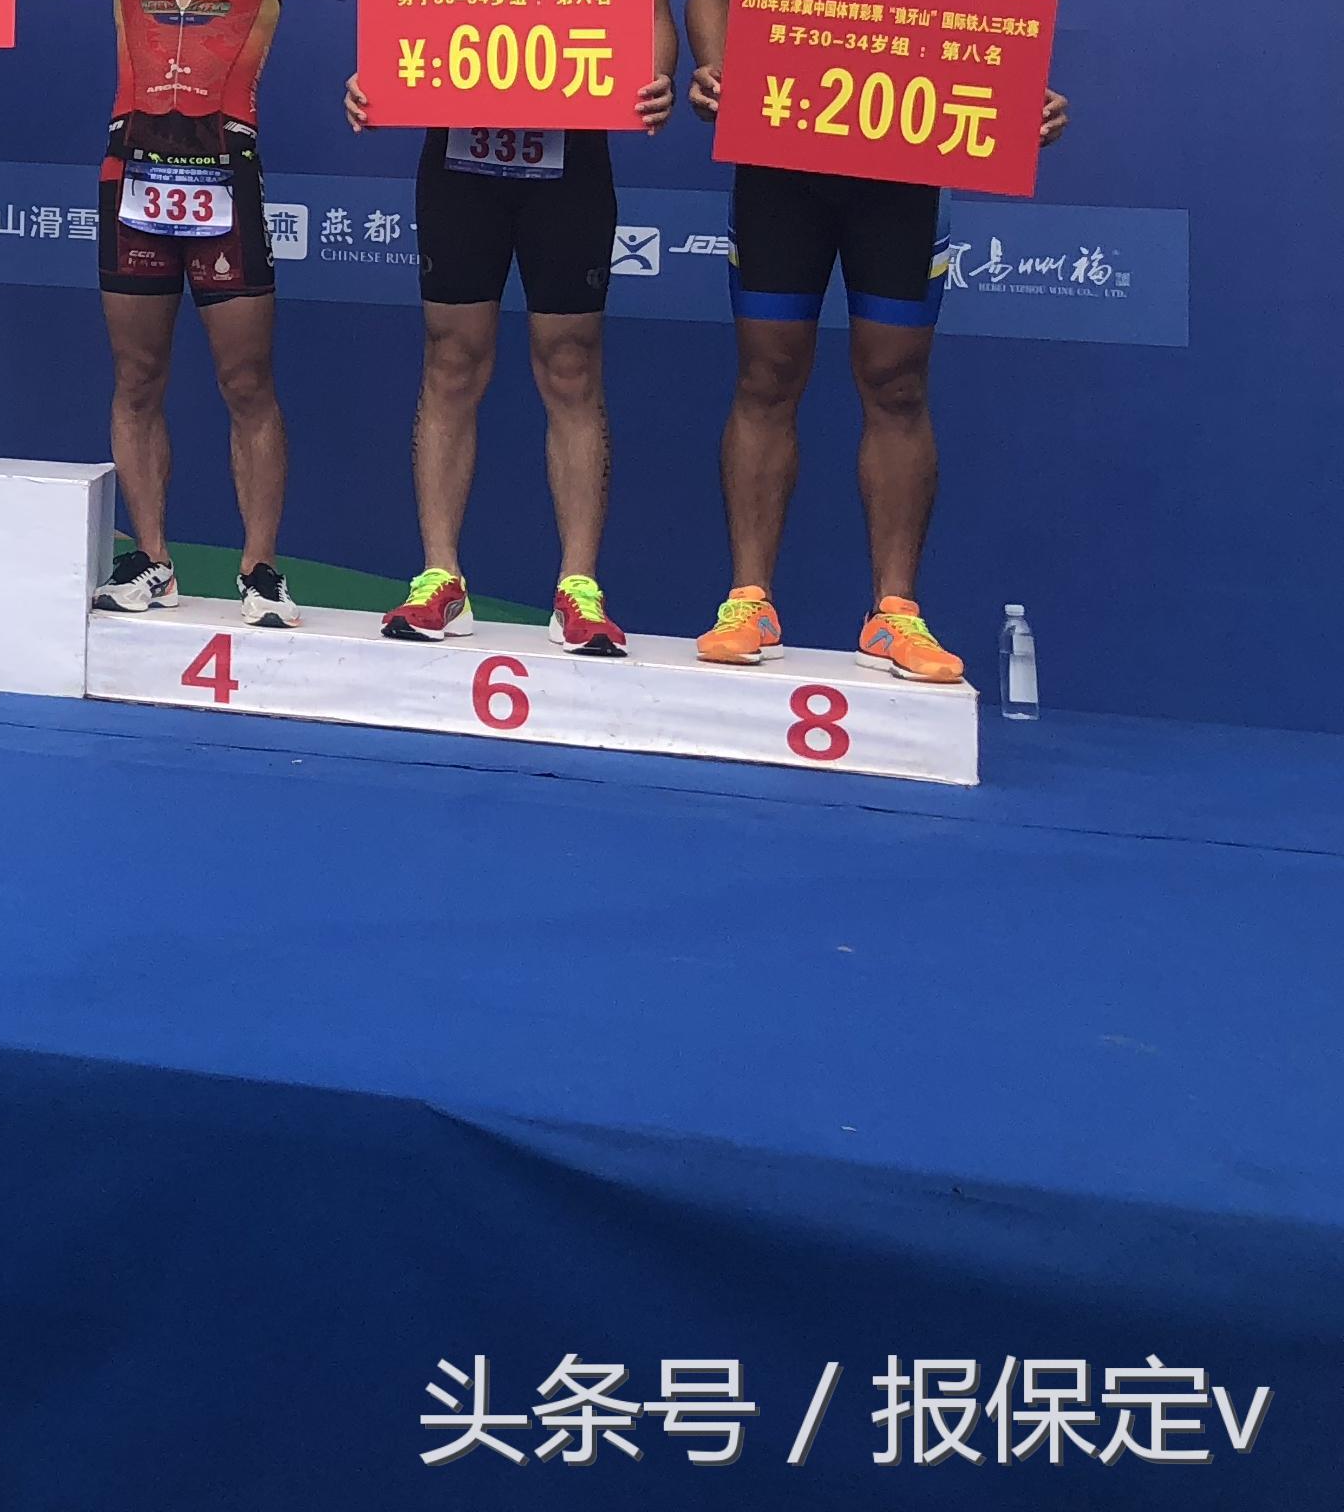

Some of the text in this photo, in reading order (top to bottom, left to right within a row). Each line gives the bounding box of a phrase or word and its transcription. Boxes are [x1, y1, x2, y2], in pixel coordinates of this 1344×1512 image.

[397, 23, 615, 99] ¥:600元
[940, 40, 1003, 66] 第八名
[761, 67, 998, 159] ¥:200元
[166, 156, 217, 165] CAN COOL
[469, 126, 545, 164] 335
[143, 186, 214, 222] 333
[320, 247, 421, 266] CHINESE RIVE
[181, 633, 239, 703] 4
[473, 655, 530, 729] 6
[787, 684, 850, 760] 8
